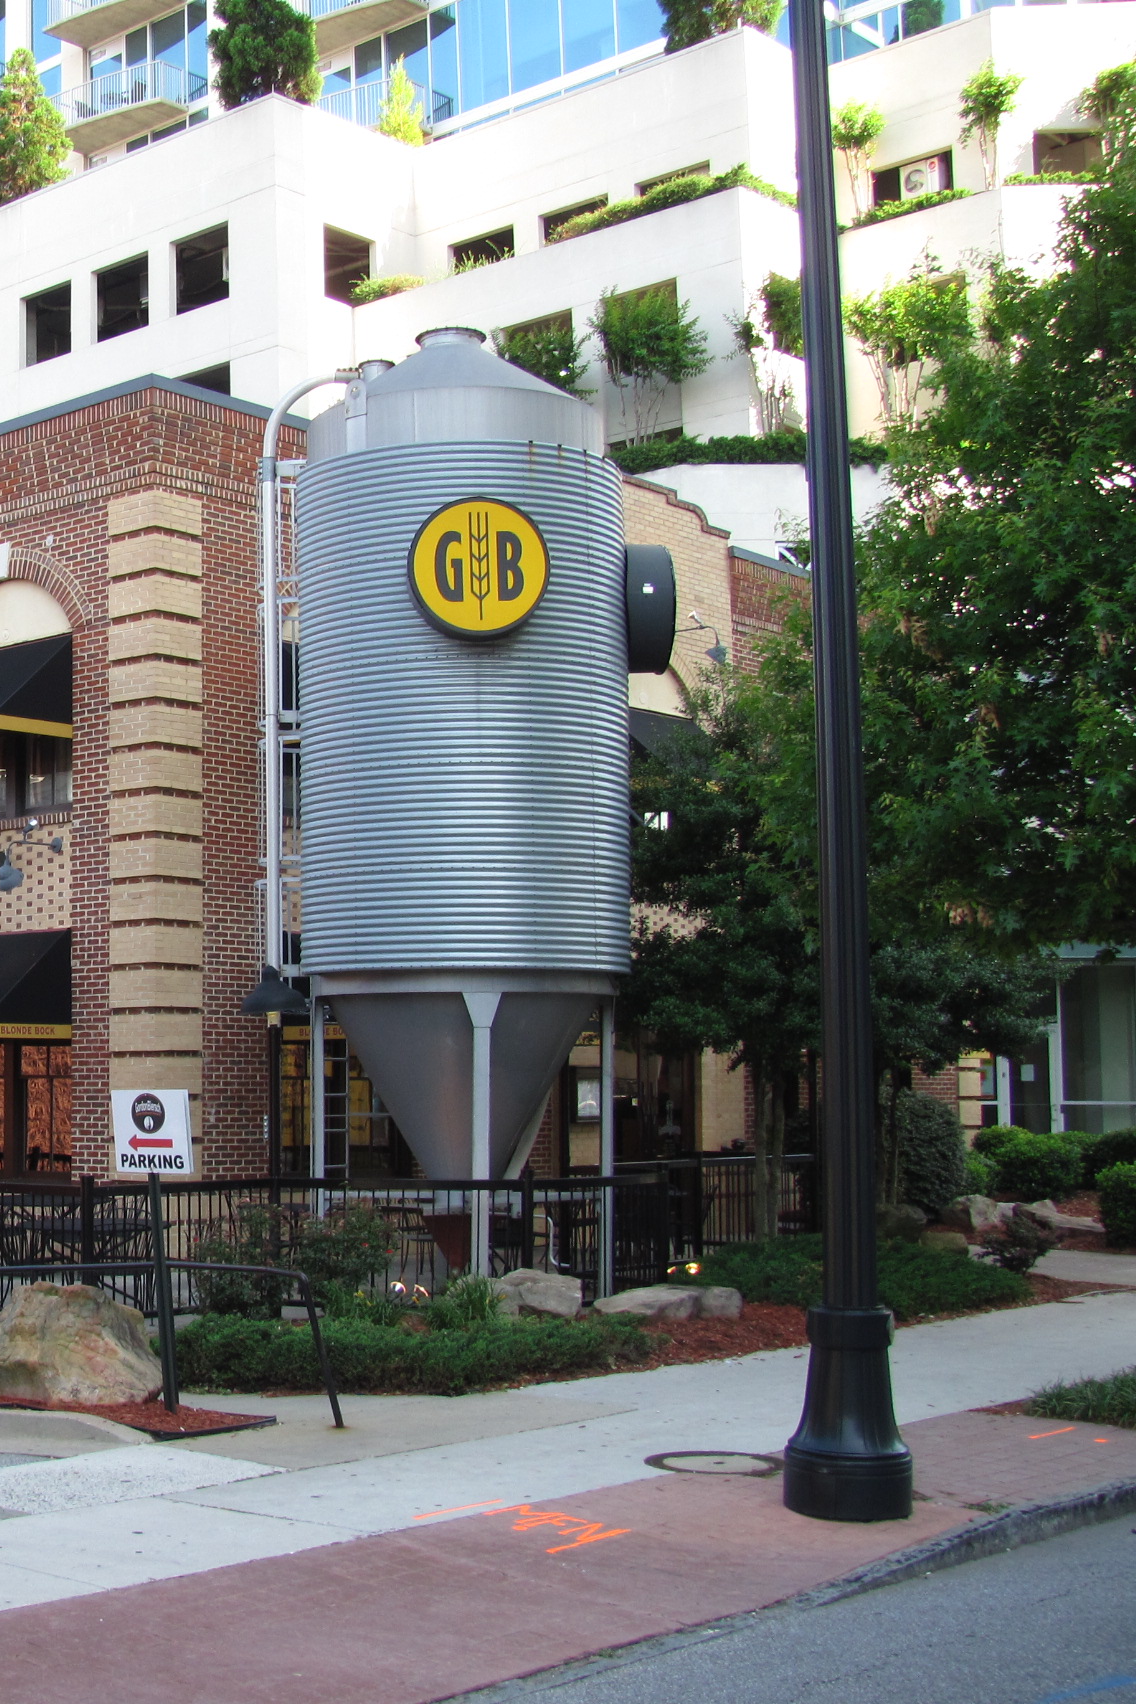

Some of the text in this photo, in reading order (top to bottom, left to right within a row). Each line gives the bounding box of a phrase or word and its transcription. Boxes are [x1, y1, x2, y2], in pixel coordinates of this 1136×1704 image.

[0, 1026, 55, 1036] BLONDE BOCK
[299, 1027, 330, 1036] BLE
[120, 1153, 184, 1169] PARKING
